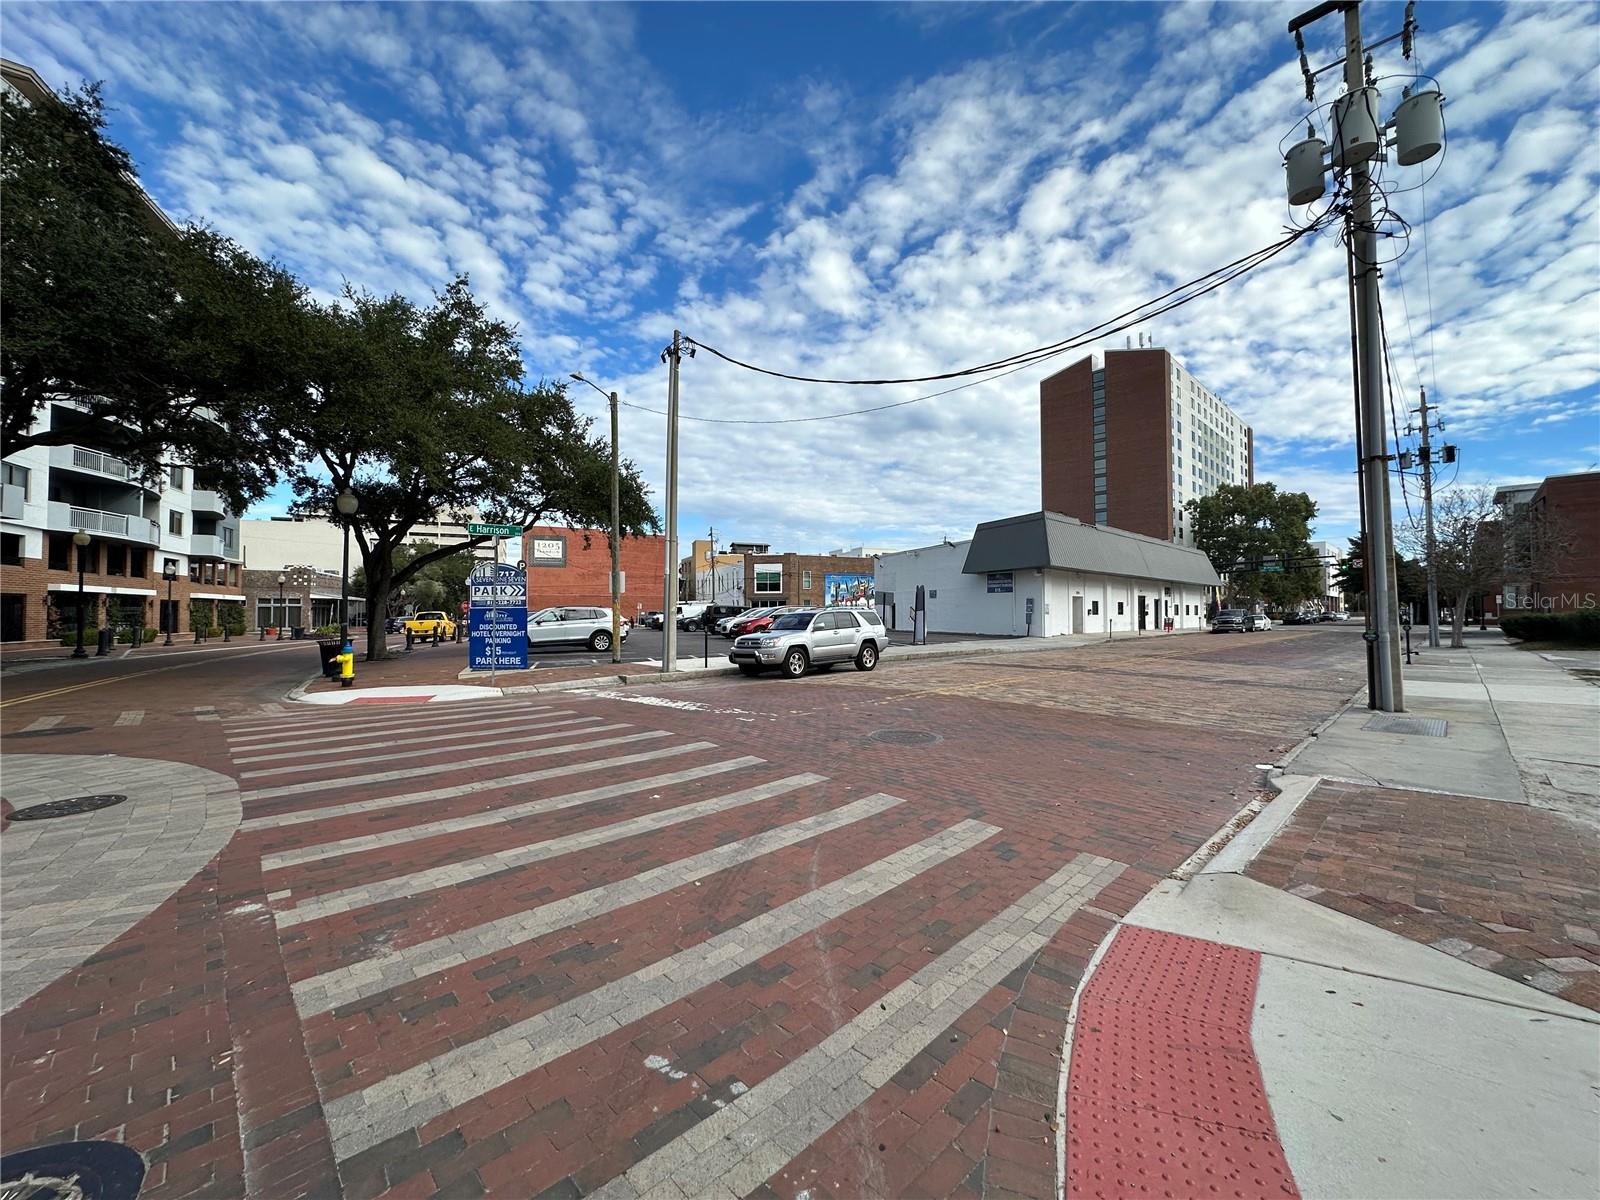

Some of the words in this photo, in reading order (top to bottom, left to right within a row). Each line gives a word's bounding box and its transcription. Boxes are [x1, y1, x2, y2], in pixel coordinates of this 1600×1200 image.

[476, 524, 510, 535] Harrison
[519, 562, 526, 571] P
[474, 586, 508, 596] PARK
[485, 646, 502, 656] $5
[475, 657, 498, 665] PARK
[498, 657, 522, 665] HERE
